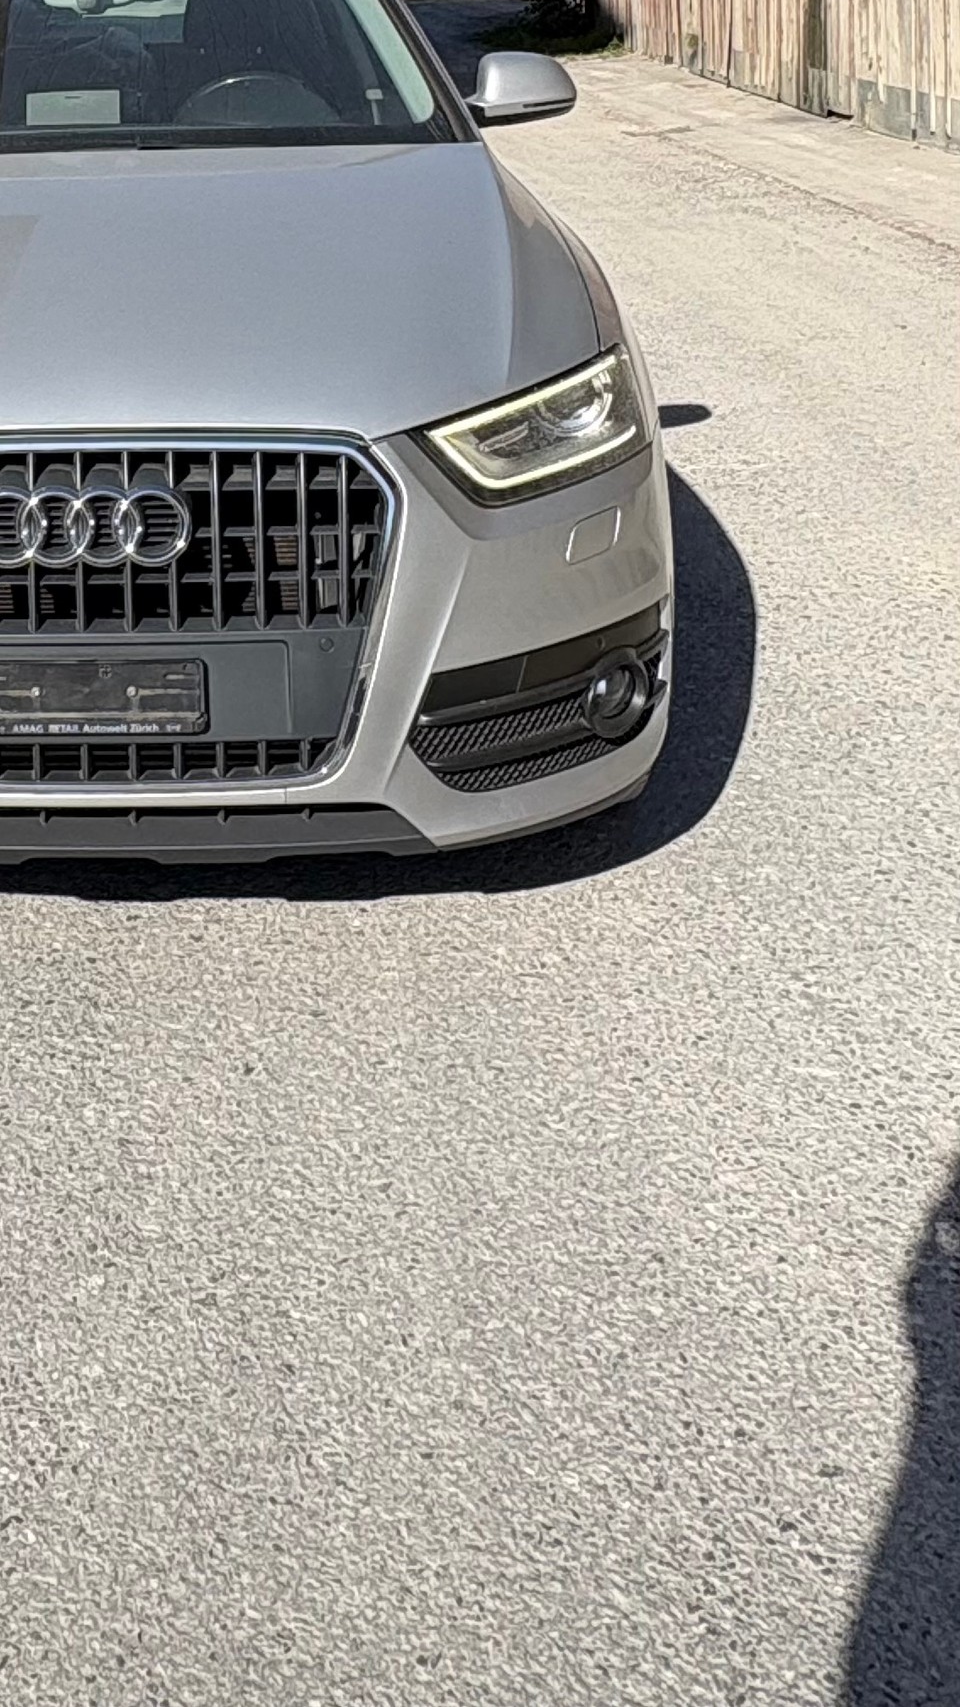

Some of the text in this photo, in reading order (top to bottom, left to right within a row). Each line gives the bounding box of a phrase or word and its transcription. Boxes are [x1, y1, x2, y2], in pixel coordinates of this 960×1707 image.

[12, 724, 43, 733] AMAG
[82, 723, 128, 733] Autowelt
[129, 723, 160, 733] Zürich
